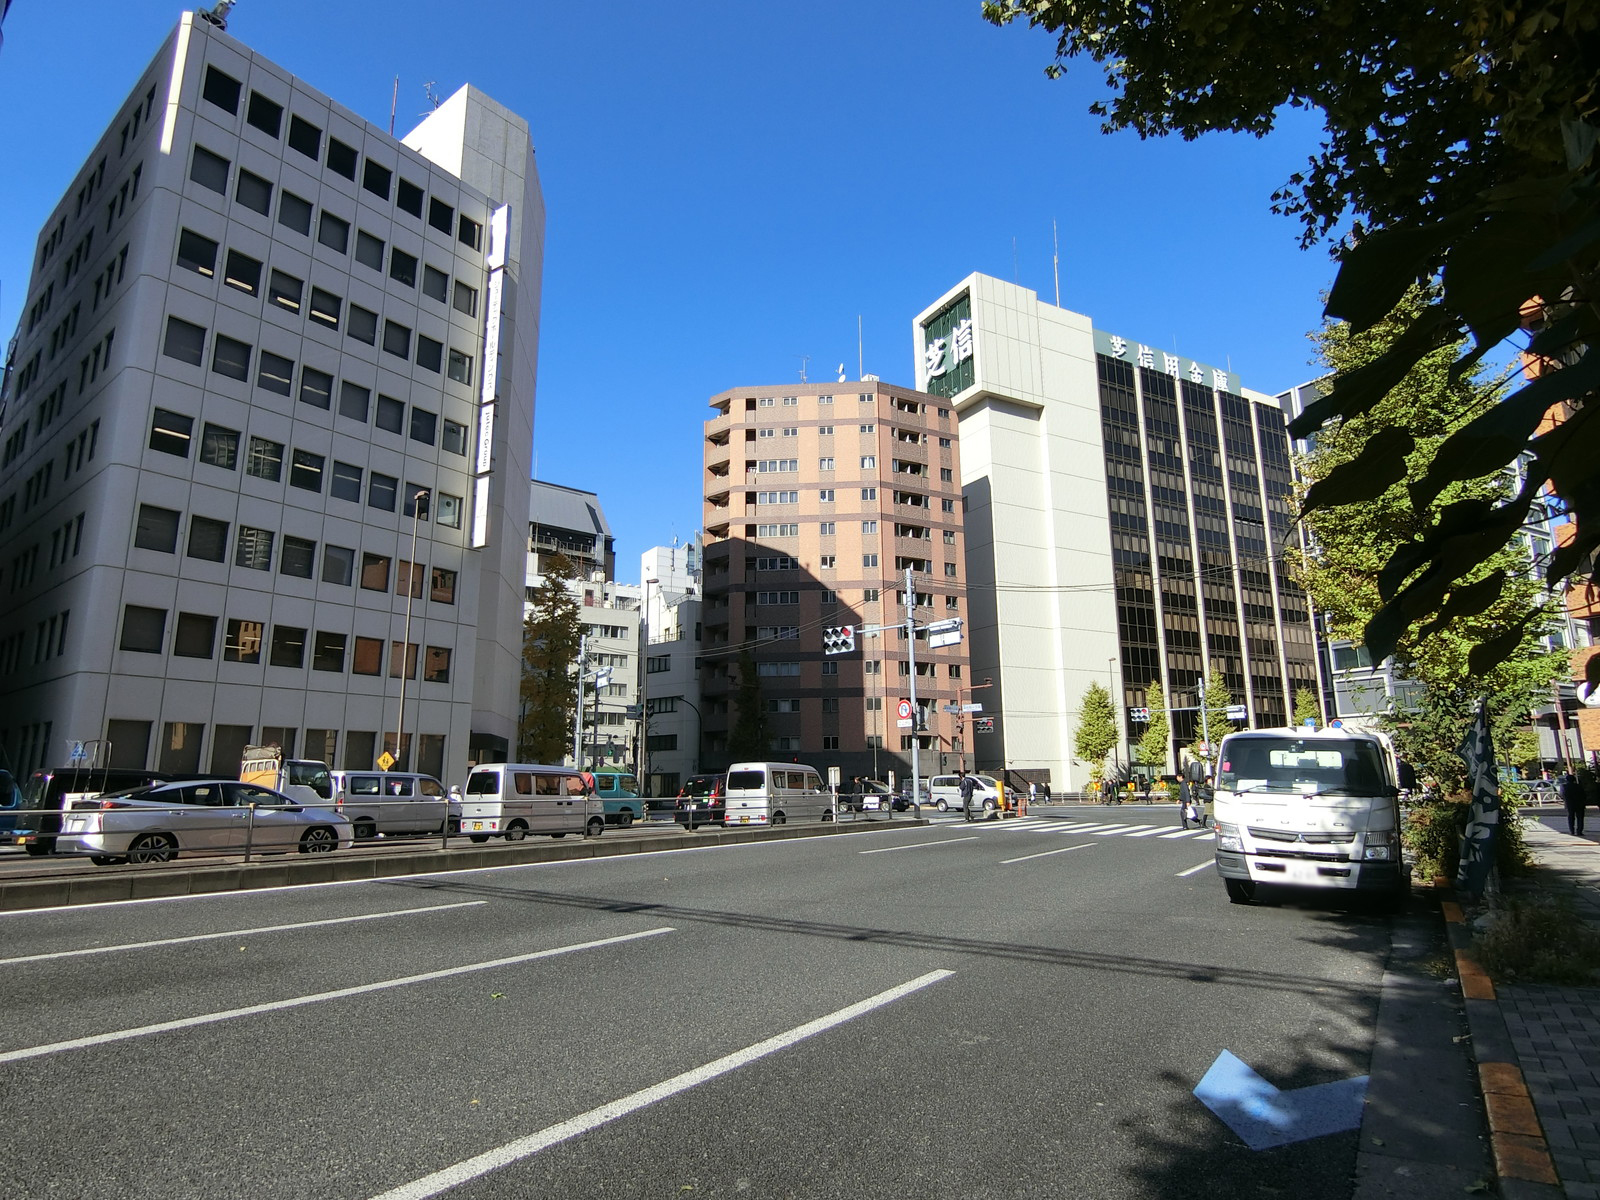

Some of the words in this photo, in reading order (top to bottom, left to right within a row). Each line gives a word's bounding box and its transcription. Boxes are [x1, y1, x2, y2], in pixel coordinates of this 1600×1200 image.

[925, 319, 973, 384] 芝信
[1109, 335, 1229, 392] 芝信用金庫
